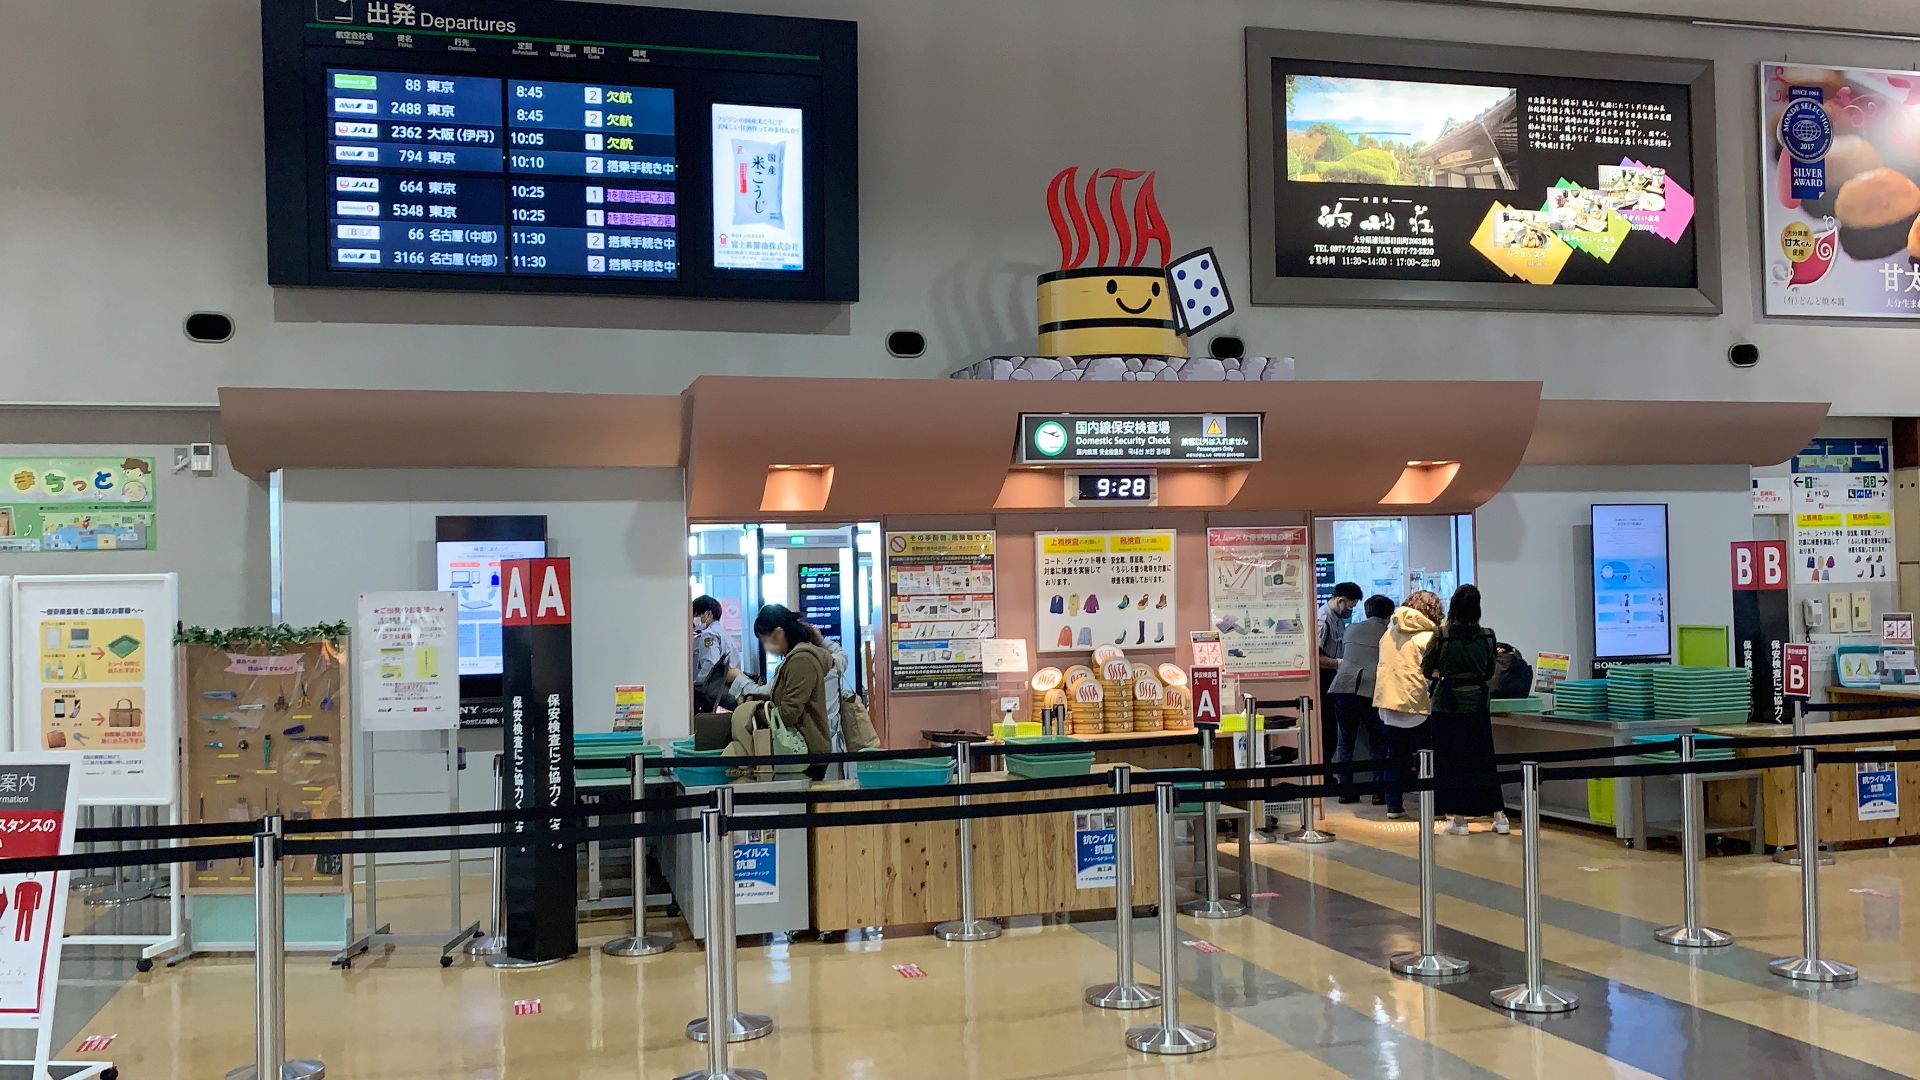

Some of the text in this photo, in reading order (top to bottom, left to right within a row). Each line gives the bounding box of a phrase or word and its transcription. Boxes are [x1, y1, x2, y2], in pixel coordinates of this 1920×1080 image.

[367, 1, 416, 26] 出発
[421, 13, 516, 33] Departures
[335, 31, 374, 41] 航空会社名
[405, 79, 455, 94] 88 東京
[516, 85, 597, 101] 8:45 2
[606, 90, 633, 104] 欠航
[390, 101, 455, 117] 2488 東京
[516, 108, 598, 124] 8:45 2
[606, 114, 633, 127] 欠航
[1783, 102, 1830, 135] MONDE SELECTION
[351, 126, 374, 134] JAL
[391, 125, 422, 139] 2362
[511, 132, 544, 146] 10:05
[606, 137, 634, 150] 欠航
[399, 149, 456, 165] 794 東京
[511, 155, 599, 171] 10:10 2
[767, 153, 777, 175] 国産
[607, 159, 674, 175] 搭乗手続き中
[1793, 167, 1823, 178] SILVER
[399, 180, 457, 195] 664 東京
[750, 155, 767, 214] 米こうじ
[1793, 179, 1823, 187] AWARD
[511, 185, 545, 199] 10:25
[393, 203, 457, 218] 5348 東京
[512, 208, 545, 222] 10:25
[408, 228, 424, 241] 66
[512, 232, 600, 246] 11:30 2
[608, 235, 675, 250] 搭乗手続き中
[1314, 244, 1329, 253] TEL
[1376, 246, 1391, 254] FAX
[1784, 238, 1811, 248] 甘太くん
[393, 251, 425, 265] 3166
[513, 255, 600, 270] 11:30 2
[608, 258, 676, 273] 搭乗手続き中
[1308, 256, 1336, 265] 営業時間
[1075, 420, 1170, 435] 国内線保安検査場
[1075, 436, 1171, 447] Domestic Security Check
[1097, 478, 1146, 497] 9:28
[1044, 556, 1107, 566] コート、ジャケット等を
[1737, 548, 1753, 585] B
[1763, 546, 1782, 584] B
[1044, 566, 1101, 576] 対象に検査を実施して
[1045, 578, 1072, 586] おります。
[1111, 575, 1166, 585] 検査を実施しております。
[505, 566, 527, 618] A
[536, 565, 566, 617] A
[1107, 663, 1128, 679] OITA
[1790, 664, 1805, 689] B
[1079, 686, 1099, 702] OITA
[1139, 681, 1157, 699] OITA
[1166, 691, 1183, 708] OITA
[1197, 689, 1217, 717] A
[0, 772, 37, 793] 案内
[1862, 774, 1892, 784] 抗ウイルス
[0, 818, 57, 833] スタンスの
[1083, 834, 1116, 845] 抗ウイル
[734, 848, 770, 858] ウイルス
